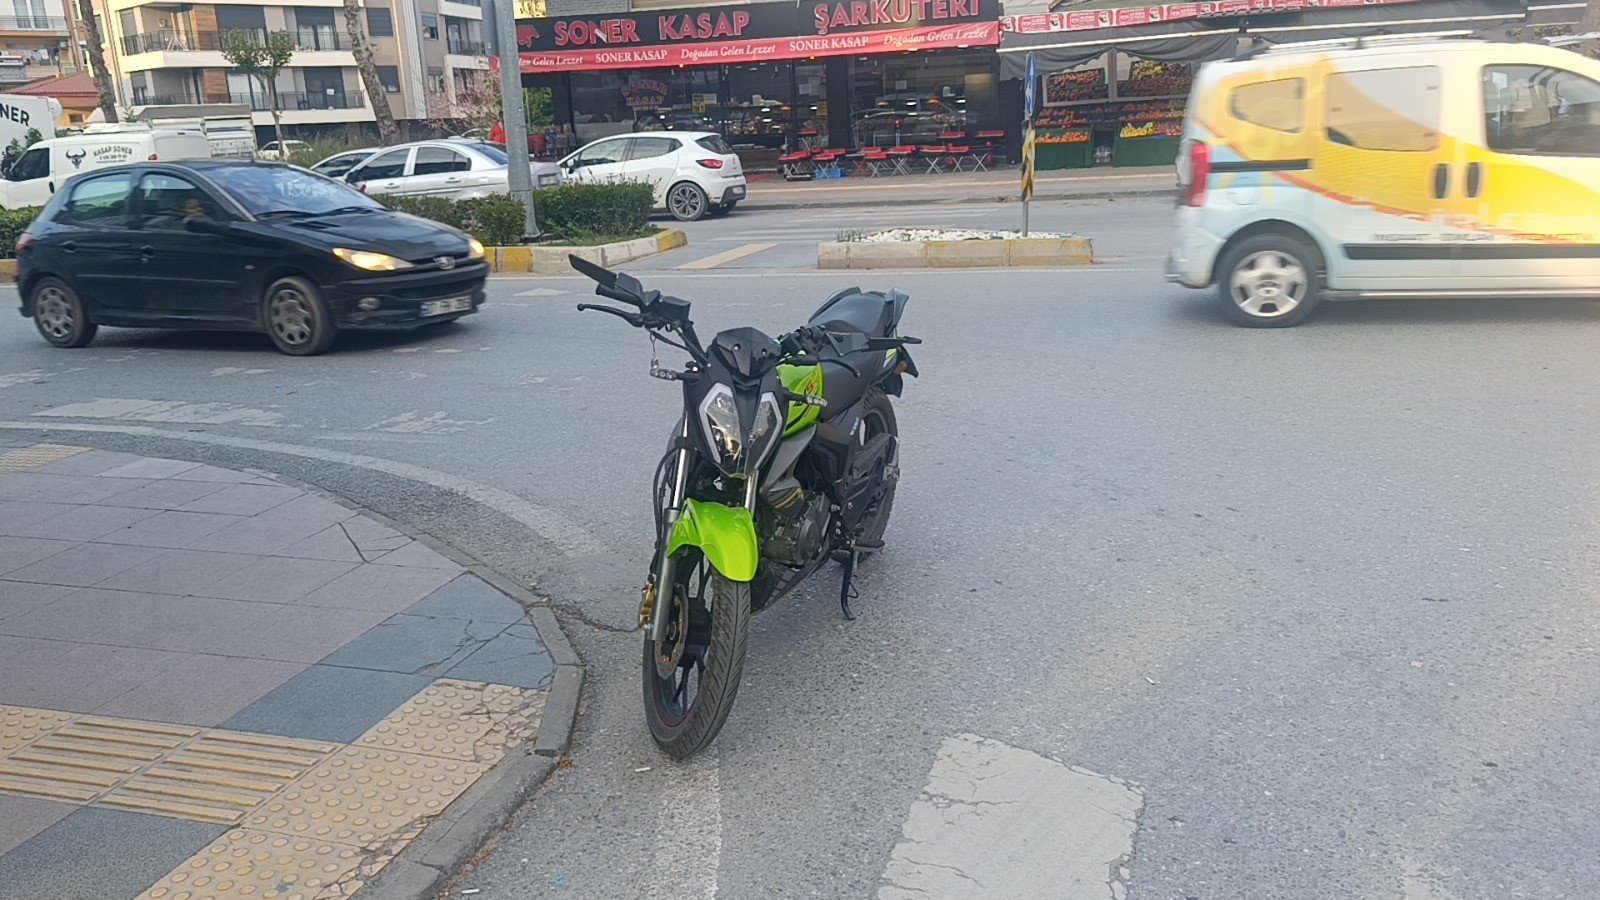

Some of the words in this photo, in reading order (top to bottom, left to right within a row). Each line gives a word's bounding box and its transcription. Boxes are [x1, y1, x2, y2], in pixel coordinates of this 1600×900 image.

[555, 19, 640, 45] SONER
[659, 11, 749, 40] KASAP
[533, 56, 555, 66] Gelen
[557, 56, 583, 66] Lezzet
[595, 52, 631, 63] SONER
[633, 49, 668, 61] KASAP
[681, 47, 718, 61] Doğadan
[720, 45, 744, 56] Gelen
[745, 44, 776, 55] Lezzet
[789, 39, 829, 52] SONER
[831, 36, 869, 49] KASAP
[927, 31, 953, 42] Gelen
[626, 95, 665, 107] KASAP
[93, 145, 112, 157] KASAP
[113, 145, 133, 155] SONER
